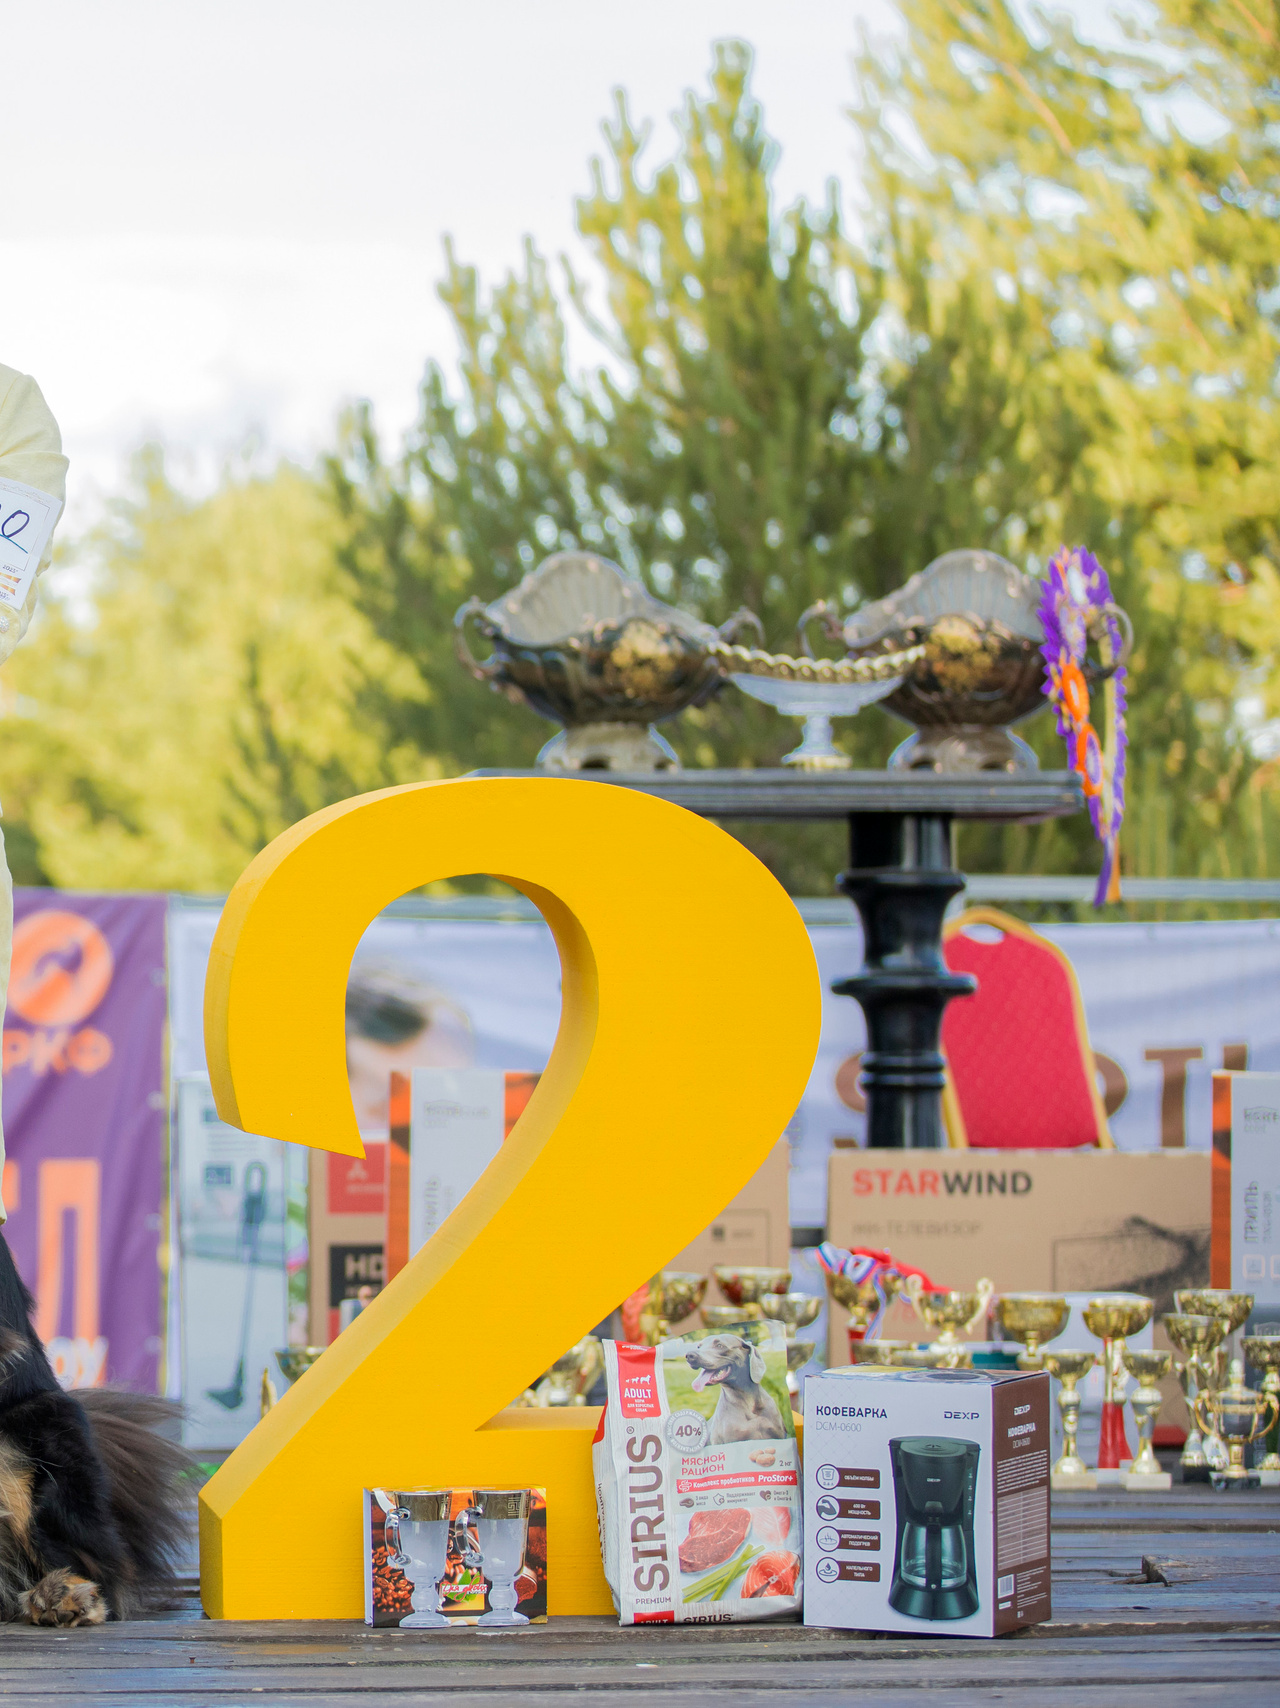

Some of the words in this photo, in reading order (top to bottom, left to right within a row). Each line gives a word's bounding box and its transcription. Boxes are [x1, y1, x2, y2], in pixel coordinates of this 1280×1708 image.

[852, 1168, 1033, 1197] STARWIND
[199, 776, 822, 1621] 2
[624, 1388, 652, 1399] ADULT
[816, 1406, 888, 1419] КОФЕВАРКА
[943, 1411, 980, 1420] DEXP
[1013, 1404, 1031, 1416] DEXP
[675, 1424, 702, 1438] 40%
[816, 1421, 862, 1432] DCM-0600
[1007, 1422, 1036, 1438] КОФЕВАРКА
[681, 1452, 726, 1466] МЯСНОЙ
[681, 1464, 725, 1476] РАЦИОН
[693, 1480, 719, 1489] Комплекс
[720, 1475, 755, 1486] пробиотиков
[758, 1474, 794, 1484] ProStor+
[626, 1434, 670, 1591] SIRIUS
[635, 1597, 671, 1605] PREMIUM
